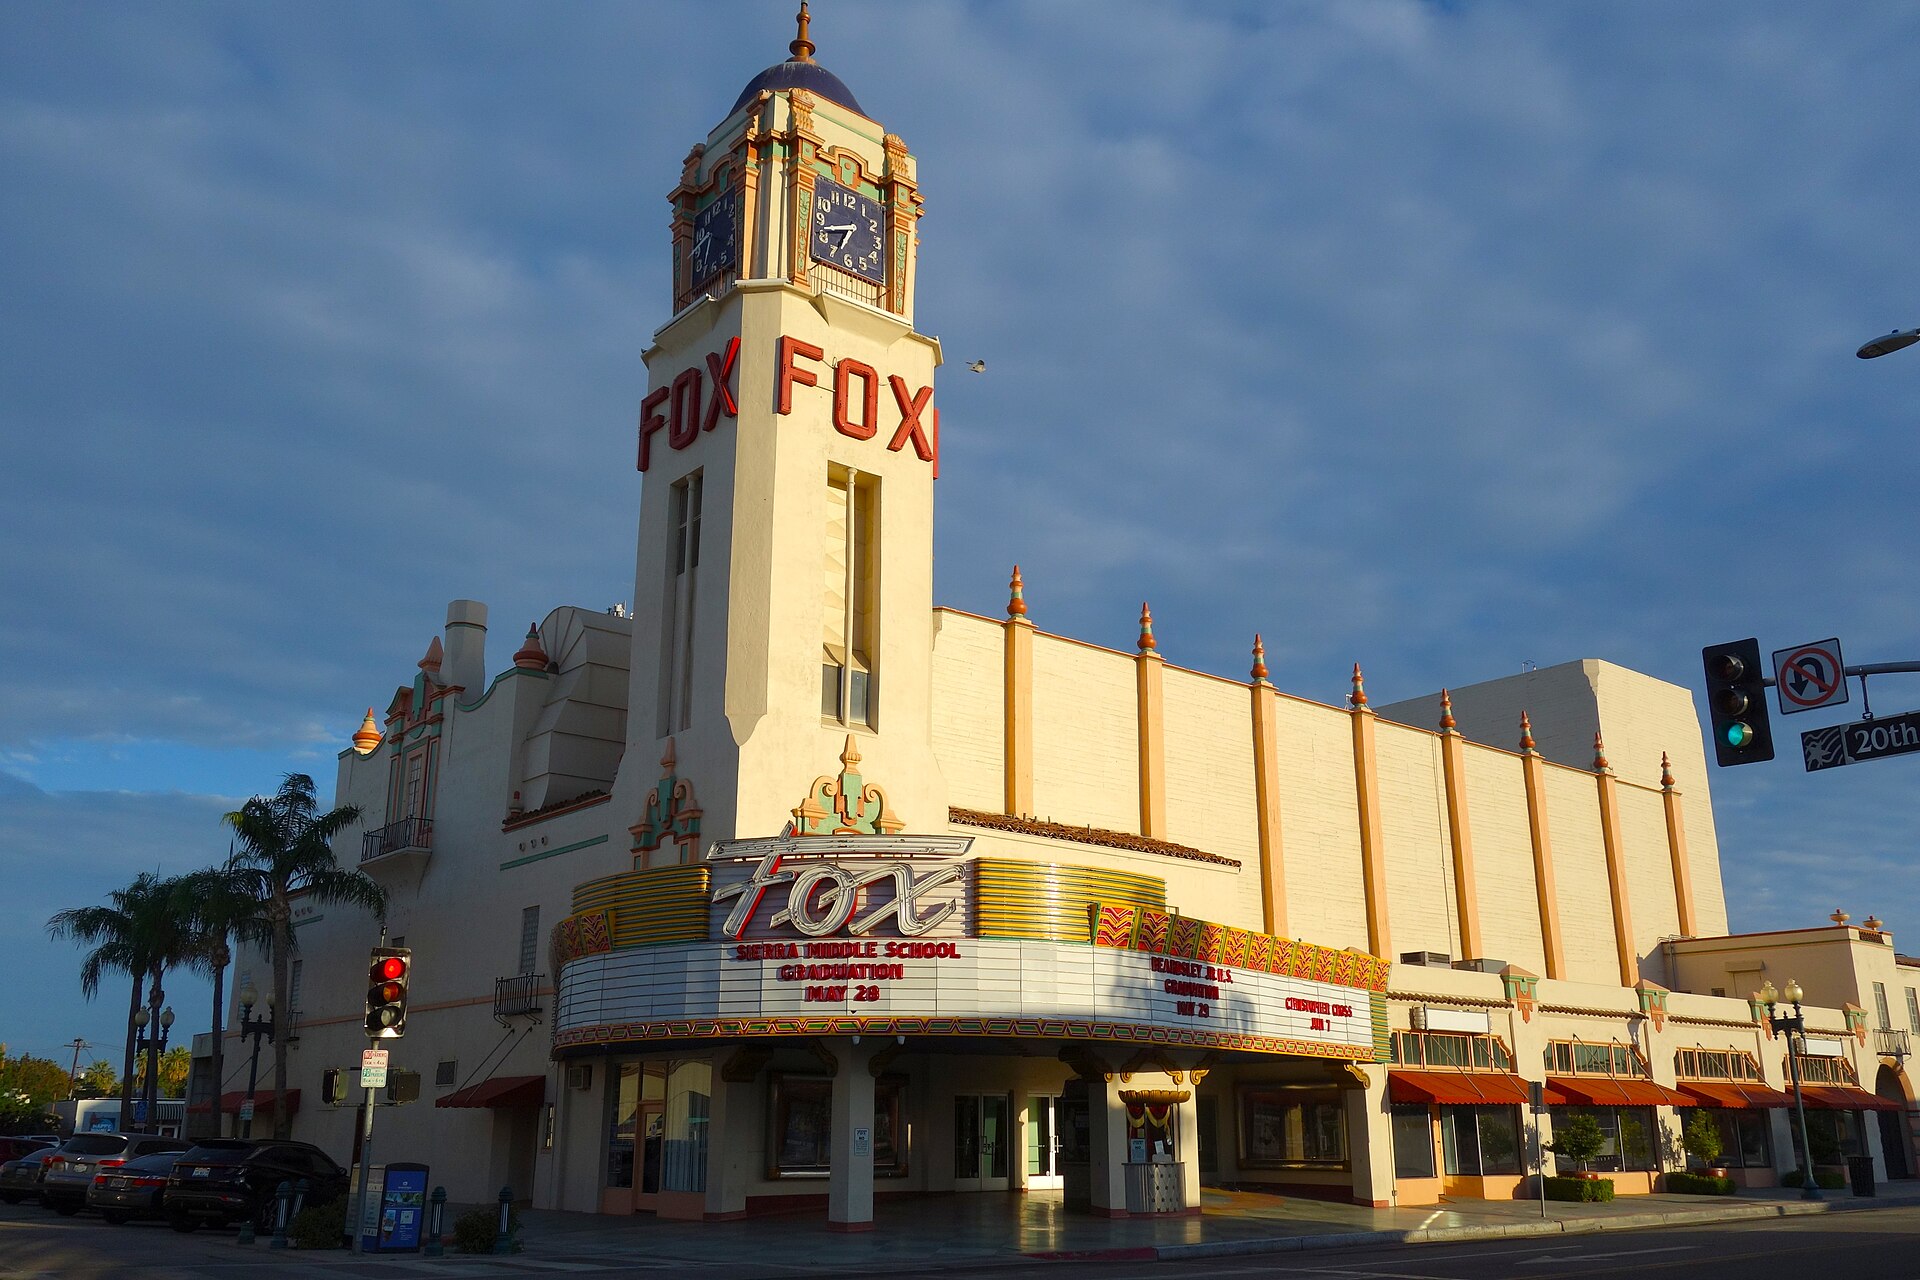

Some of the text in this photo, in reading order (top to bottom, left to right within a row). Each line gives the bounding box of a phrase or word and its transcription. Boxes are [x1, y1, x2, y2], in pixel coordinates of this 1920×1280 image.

[725, 198, 727, 210] 1
[818, 196, 830, 213] 10
[831, 190, 839, 205] 11
[843, 193, 855, 210] 12
[712, 201, 721, 217] 12
[729, 204, 734, 218] 2
[861, 204, 866, 217] 1
[705, 212, 710, 226] 11
[816, 212, 825, 225] 9
[870, 219, 877, 232] 2
[696, 228, 704, 243] 10
[727, 234, 734, 246] 4
[819, 229, 828, 243] 8
[873, 236, 881, 250] 3
[721, 251, 727, 264] 5
[830, 245, 838, 257] 7
[868, 251, 878, 264] 4
[696, 259, 702, 272] 8
[711, 261, 717, 273] 6
[843, 254, 853, 267] 6
[858, 257, 867, 271] 5
[637, 336, 741, 472] FOX
[777, 335, 934, 462] FOX
[1855, 723, 1920, 754] 20th
[736, 942, 961, 960] SIERRA MIDDLE SCHOOL
[780, 963, 904, 980] GRADUATION
[804, 984, 880, 1001] MAY 28
[1165, 979, 1219, 1000] GRADUATION
[1177, 1001, 1209, 1018] MAY 29
[1332, 1004, 1352, 1017] CROSS
[1310, 1018, 1330, 1032] JUN 7
